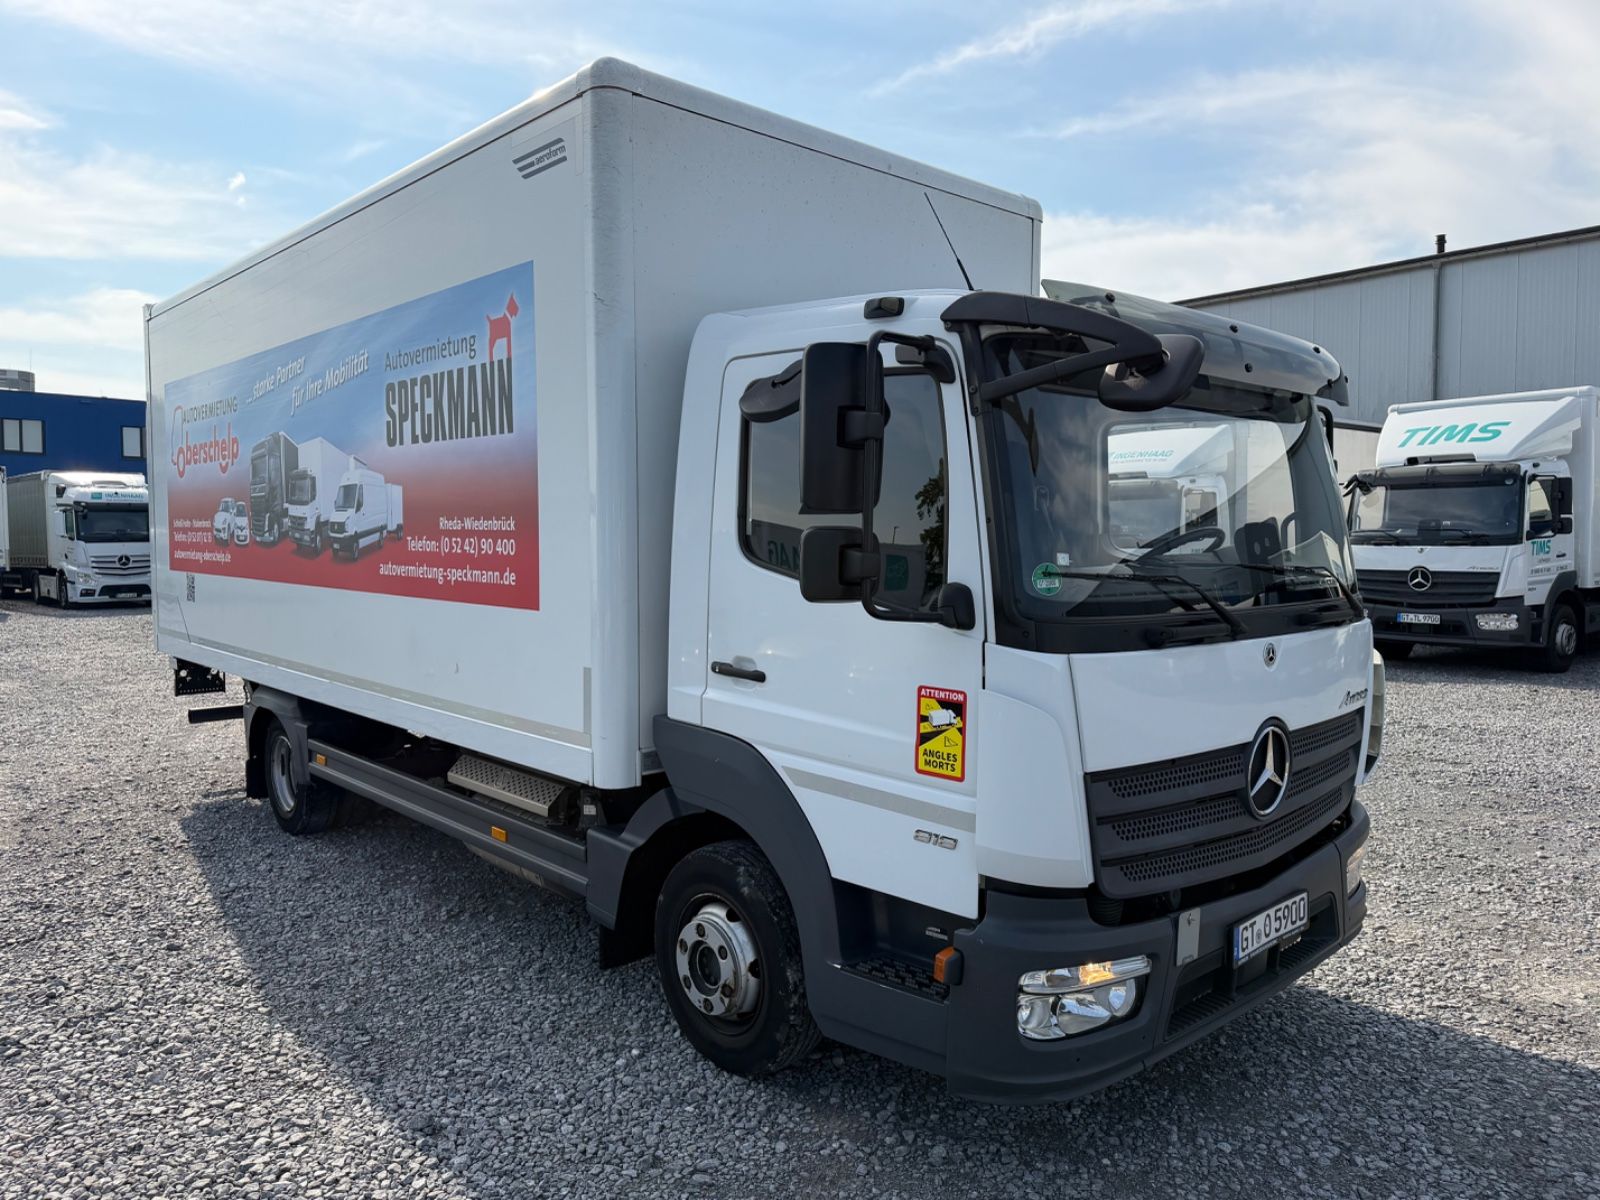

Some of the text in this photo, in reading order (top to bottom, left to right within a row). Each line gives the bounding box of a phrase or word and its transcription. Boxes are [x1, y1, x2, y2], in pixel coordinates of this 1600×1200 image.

[385, 334, 477, 371] Autovermietung
[276, 356, 306, 388] Partner
[291, 348, 369, 417] für Ihre Mobilität
[182, 396, 238, 424] AUTOVERMIETUNG
[385, 357, 514, 448] SPECKMANN
[1398, 421, 1512, 448] TIMS
[439, 516, 516, 531] Rheda-Wiedenbrück
[407, 536, 516, 558] Telefon: (0 52 42) 90 400
[1531, 539, 1552, 556] TIMS
[379, 561, 516, 586] autovermietung-speckmann.de
[920, 688, 964, 702] ATTENTION
[922, 748, 958, 763] ANGLES
[924, 758, 956, 773] MORTS
[1241, 920, 1257, 952] GT
[1274, 896, 1306, 934] 5900
